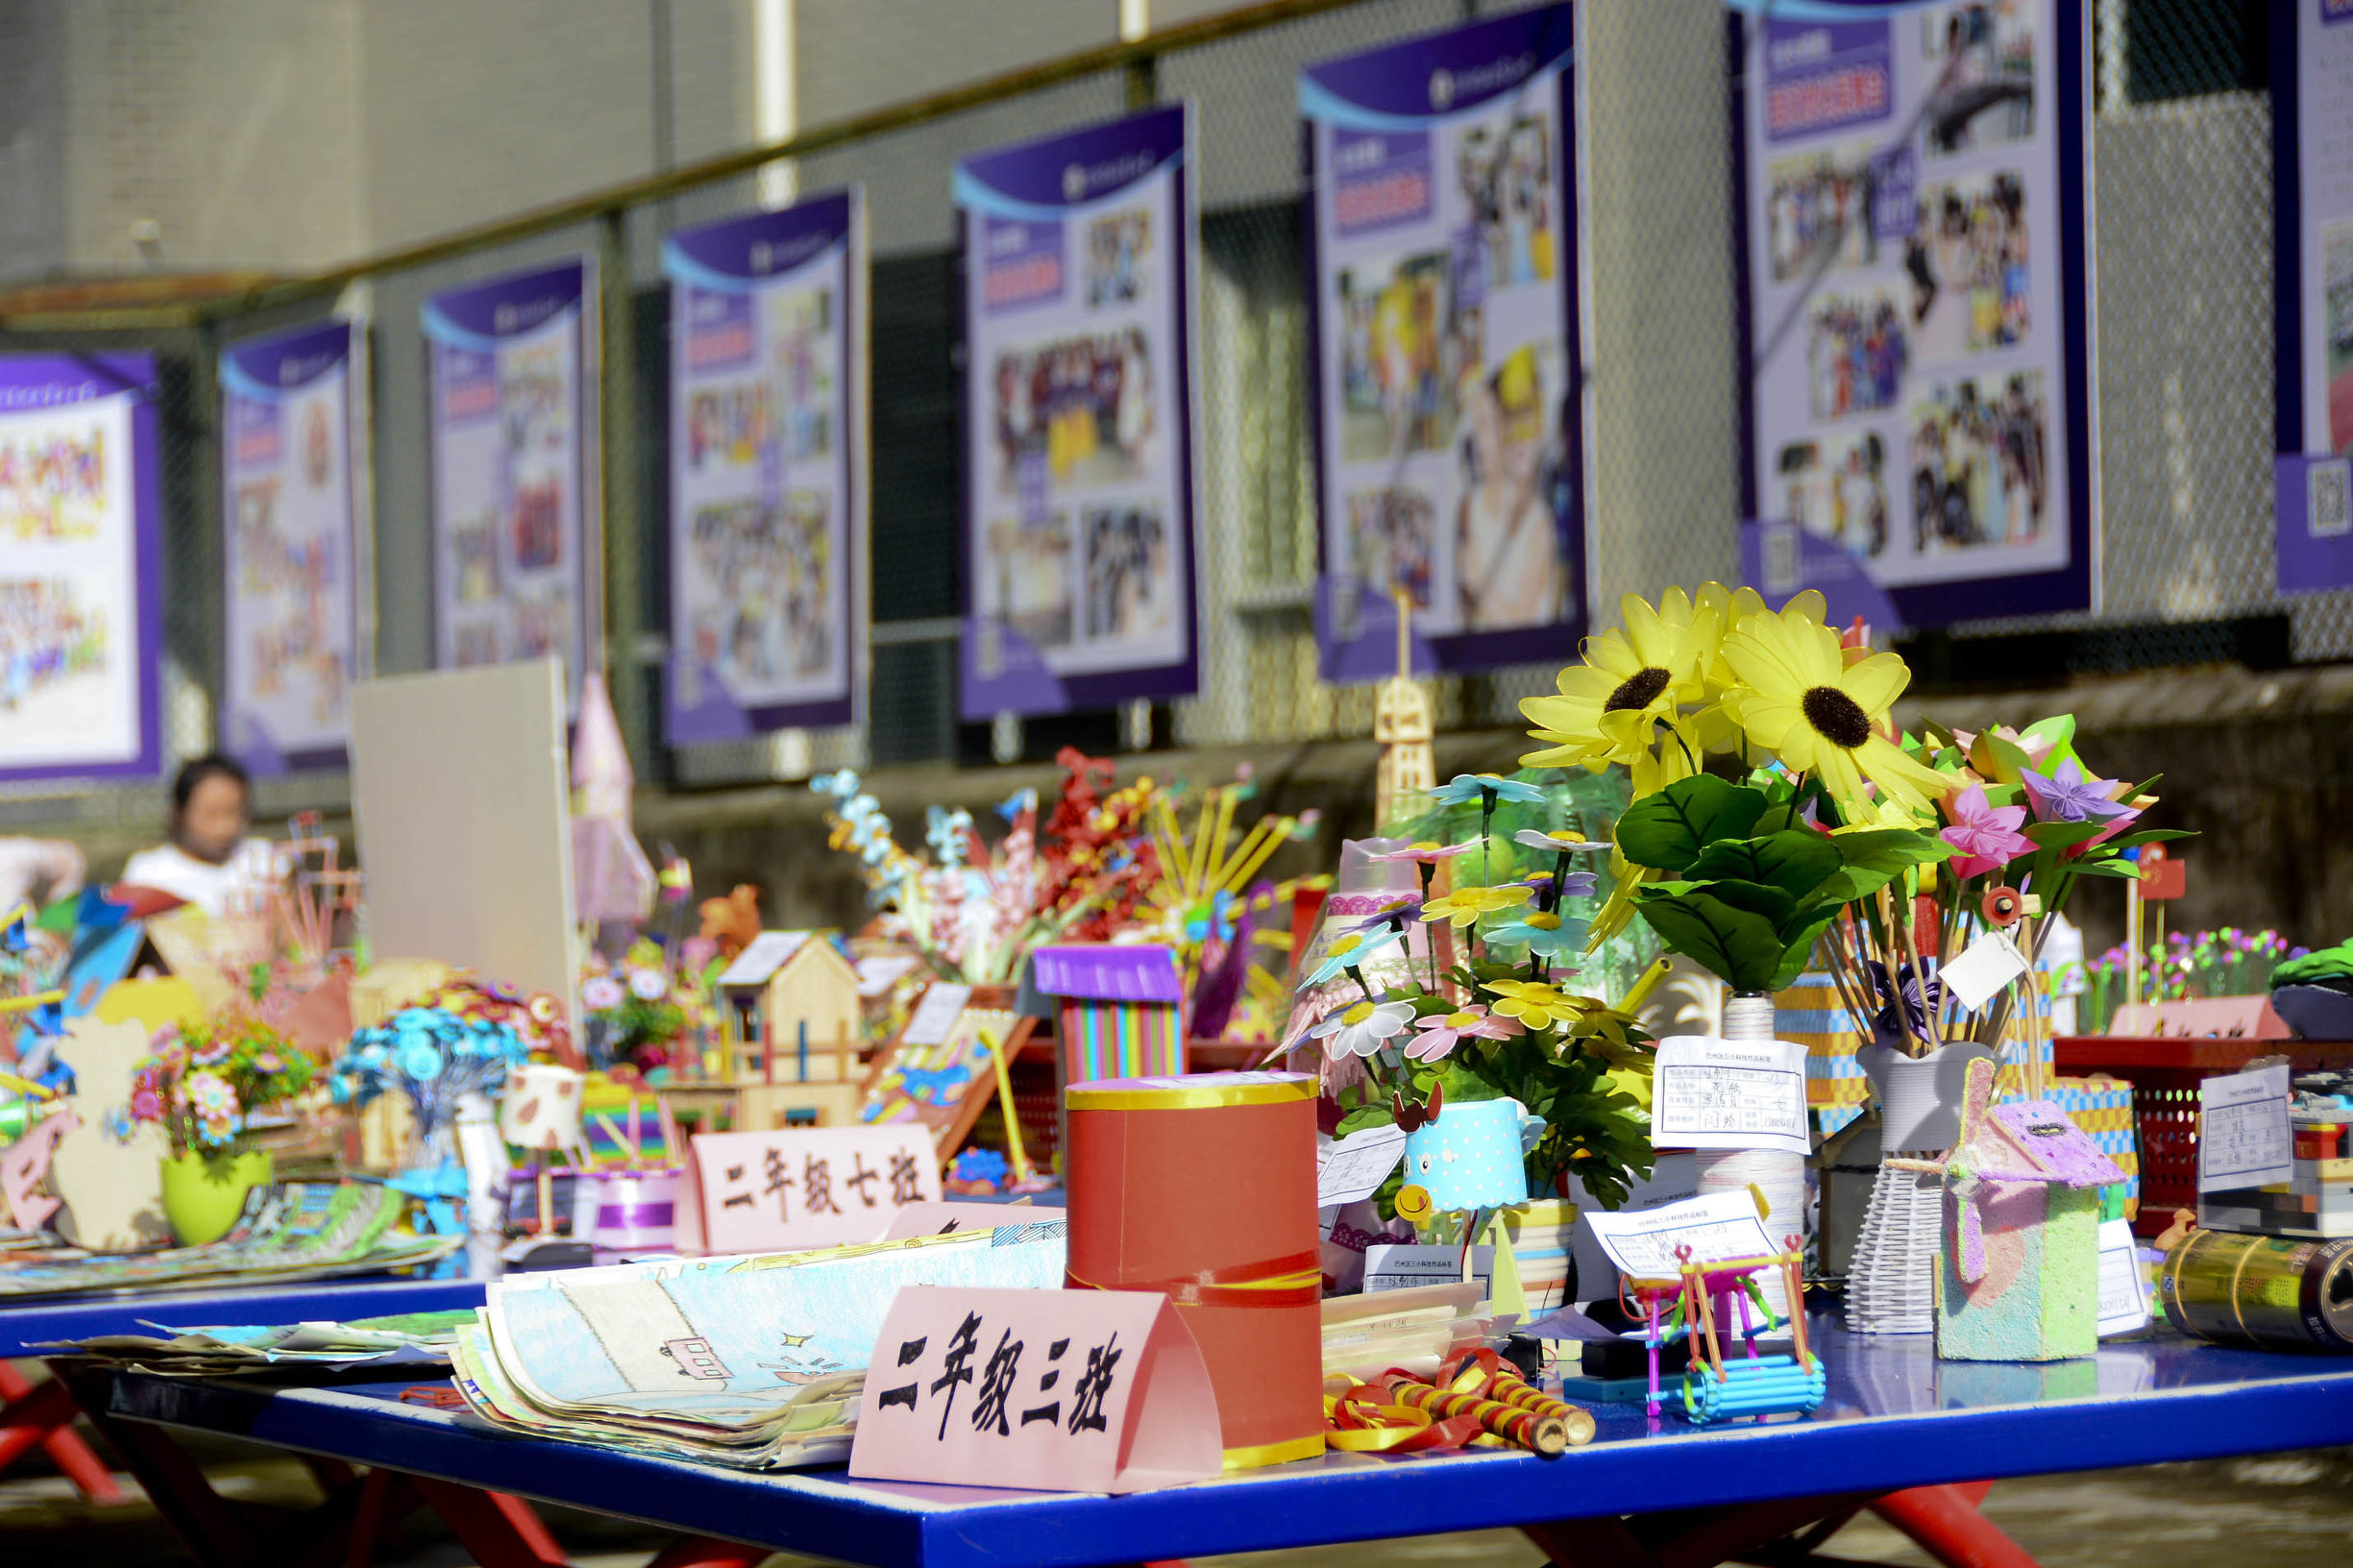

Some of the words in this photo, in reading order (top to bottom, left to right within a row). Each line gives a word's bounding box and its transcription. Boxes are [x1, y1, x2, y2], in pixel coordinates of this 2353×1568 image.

[723, 1146, 925, 1224] 二年级七班
[878, 1310, 1123, 1441] 二年级三班
